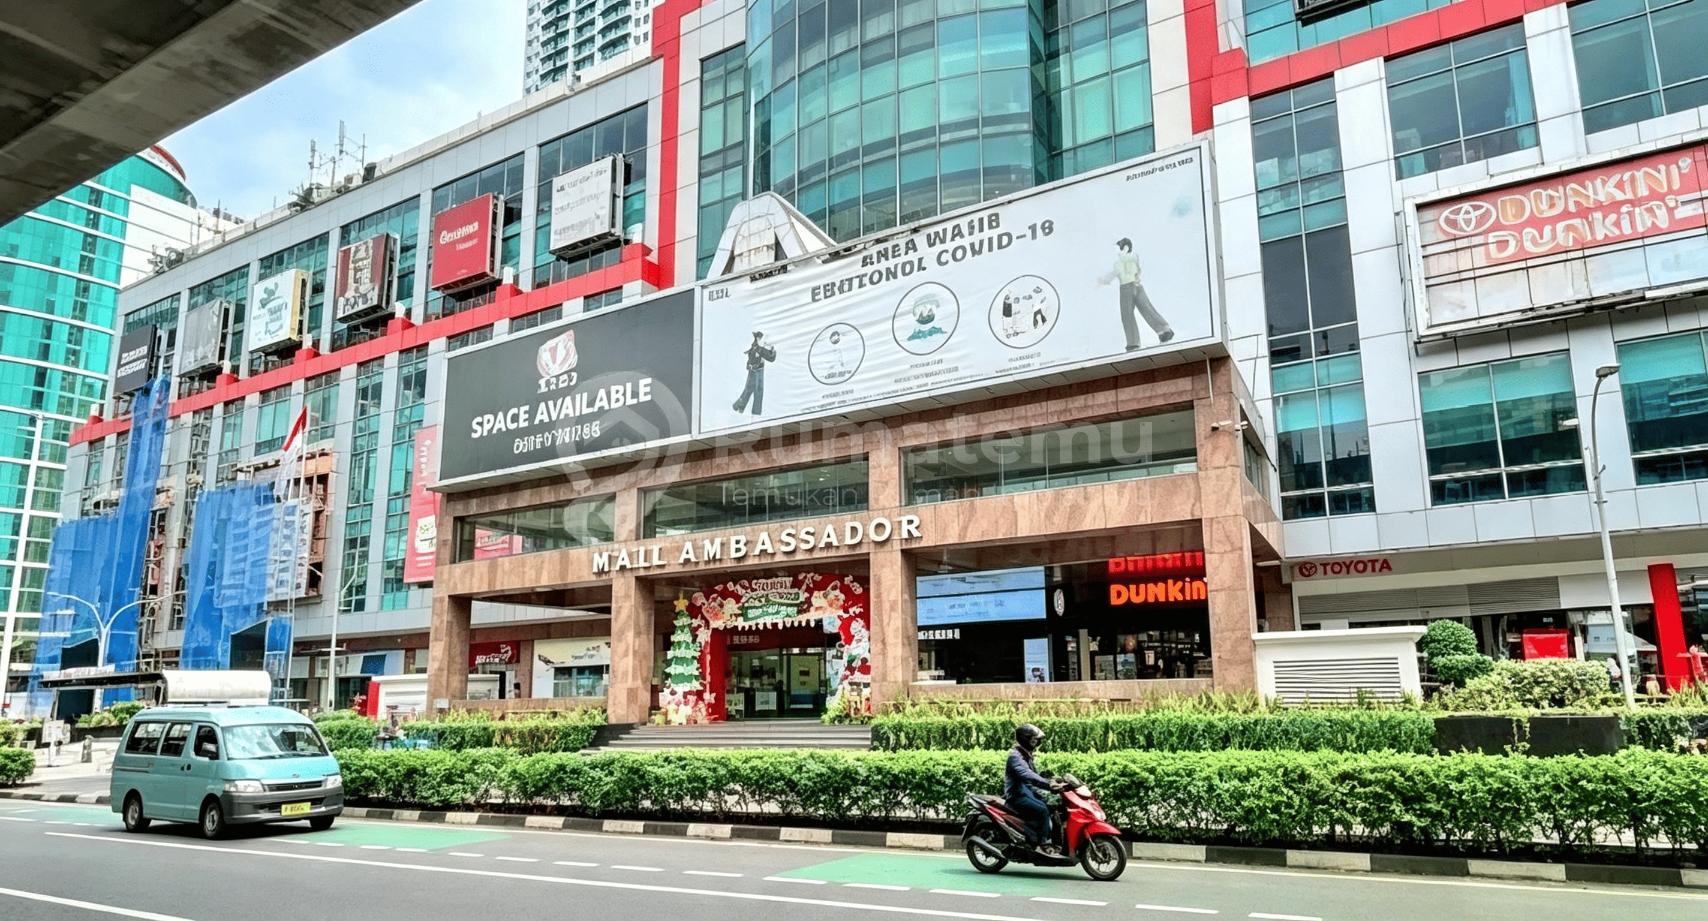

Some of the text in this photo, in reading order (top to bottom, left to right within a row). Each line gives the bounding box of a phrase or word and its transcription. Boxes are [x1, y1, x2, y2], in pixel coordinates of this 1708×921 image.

[471, 405, 530, 438] SPACE
[534, 377, 652, 424] AVAILABLE
[592, 514, 922, 573] MALL AMBASSADOR
[1319, 558, 1393, 576] TOYOTA
